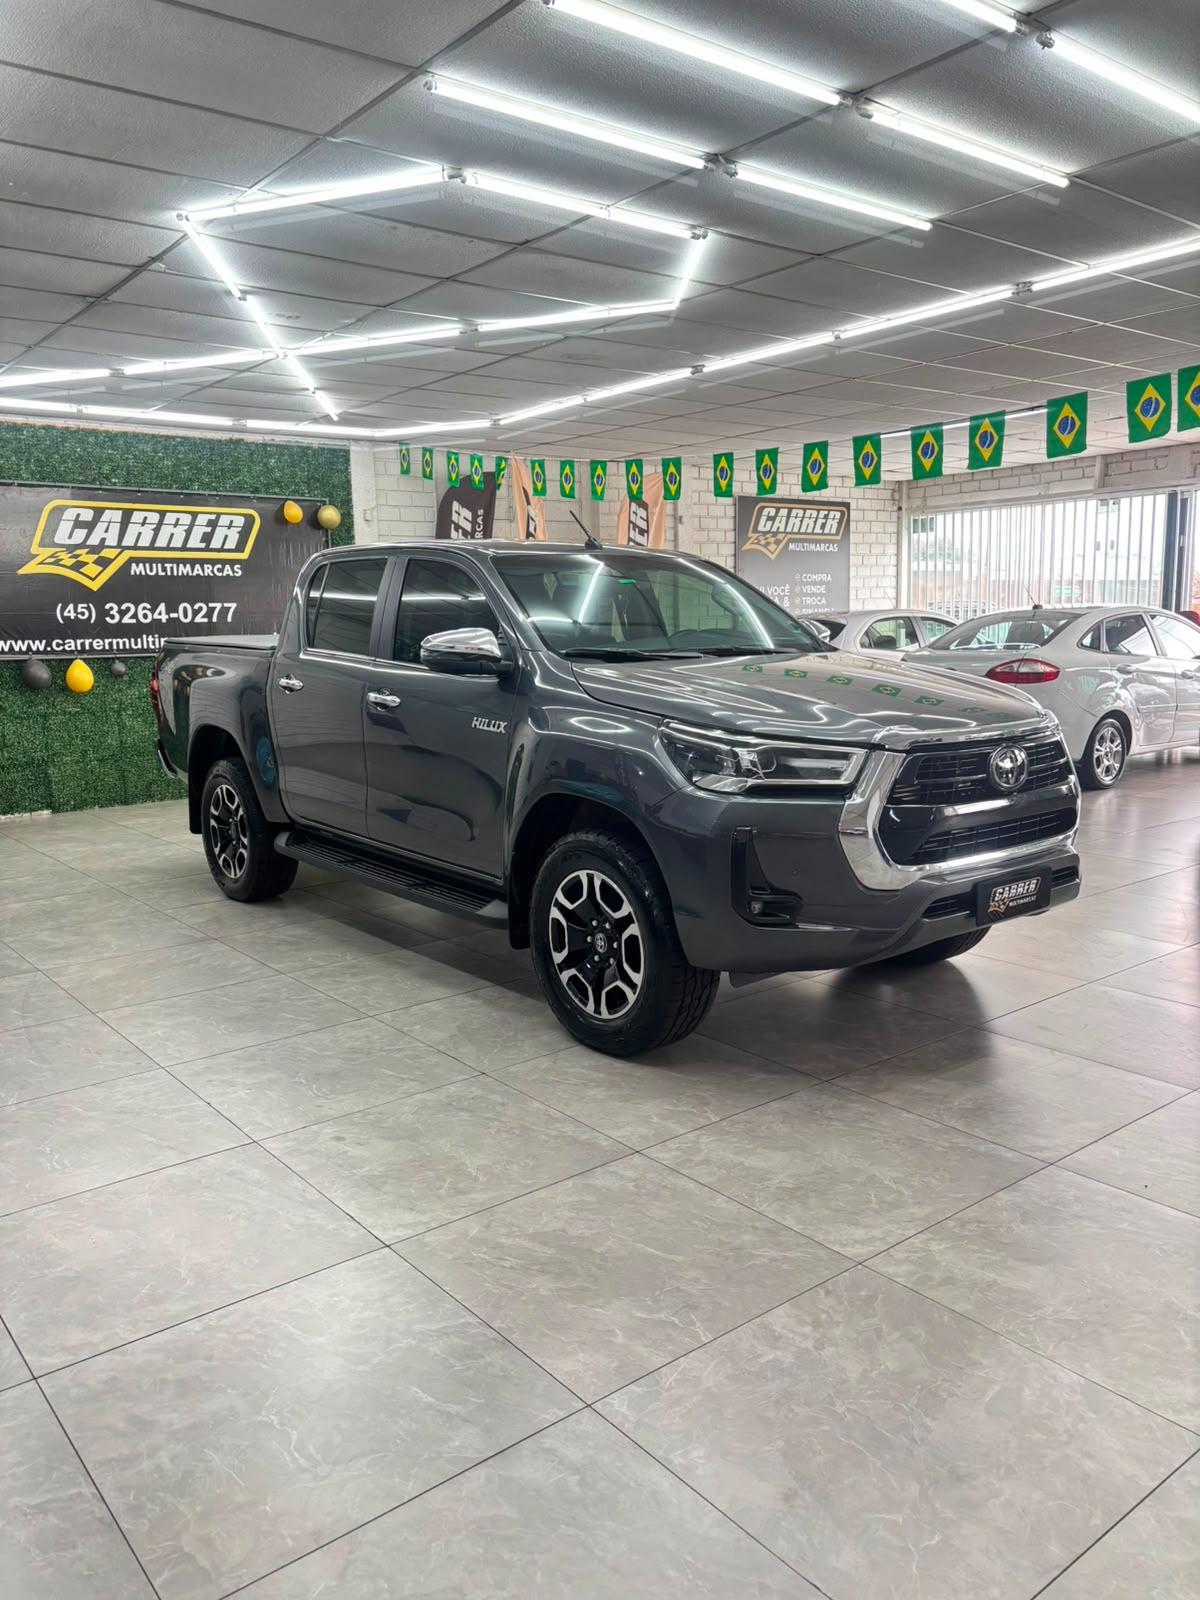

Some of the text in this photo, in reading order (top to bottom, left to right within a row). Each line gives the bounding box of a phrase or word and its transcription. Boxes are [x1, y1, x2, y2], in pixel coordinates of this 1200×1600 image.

[53, 507, 245, 550] CARRER
[630, 501, 648, 546] ER
[757, 507, 841, 534] CARRER
[788, 542, 838, 552] MULTIMARCAS
[130, 563, 242, 577] MULTIMARCAS
[801, 573, 832, 582] COMPRA
[767, 584, 791, 596] VOCÊ
[801, 585, 827, 594] VENDE
[801, 596, 827, 605] TROCA
[56, 602, 238, 624] (45) 3264-0277
[471, 716, 508, 734] HILUX
[994, 879, 1038, 901] CARRER
